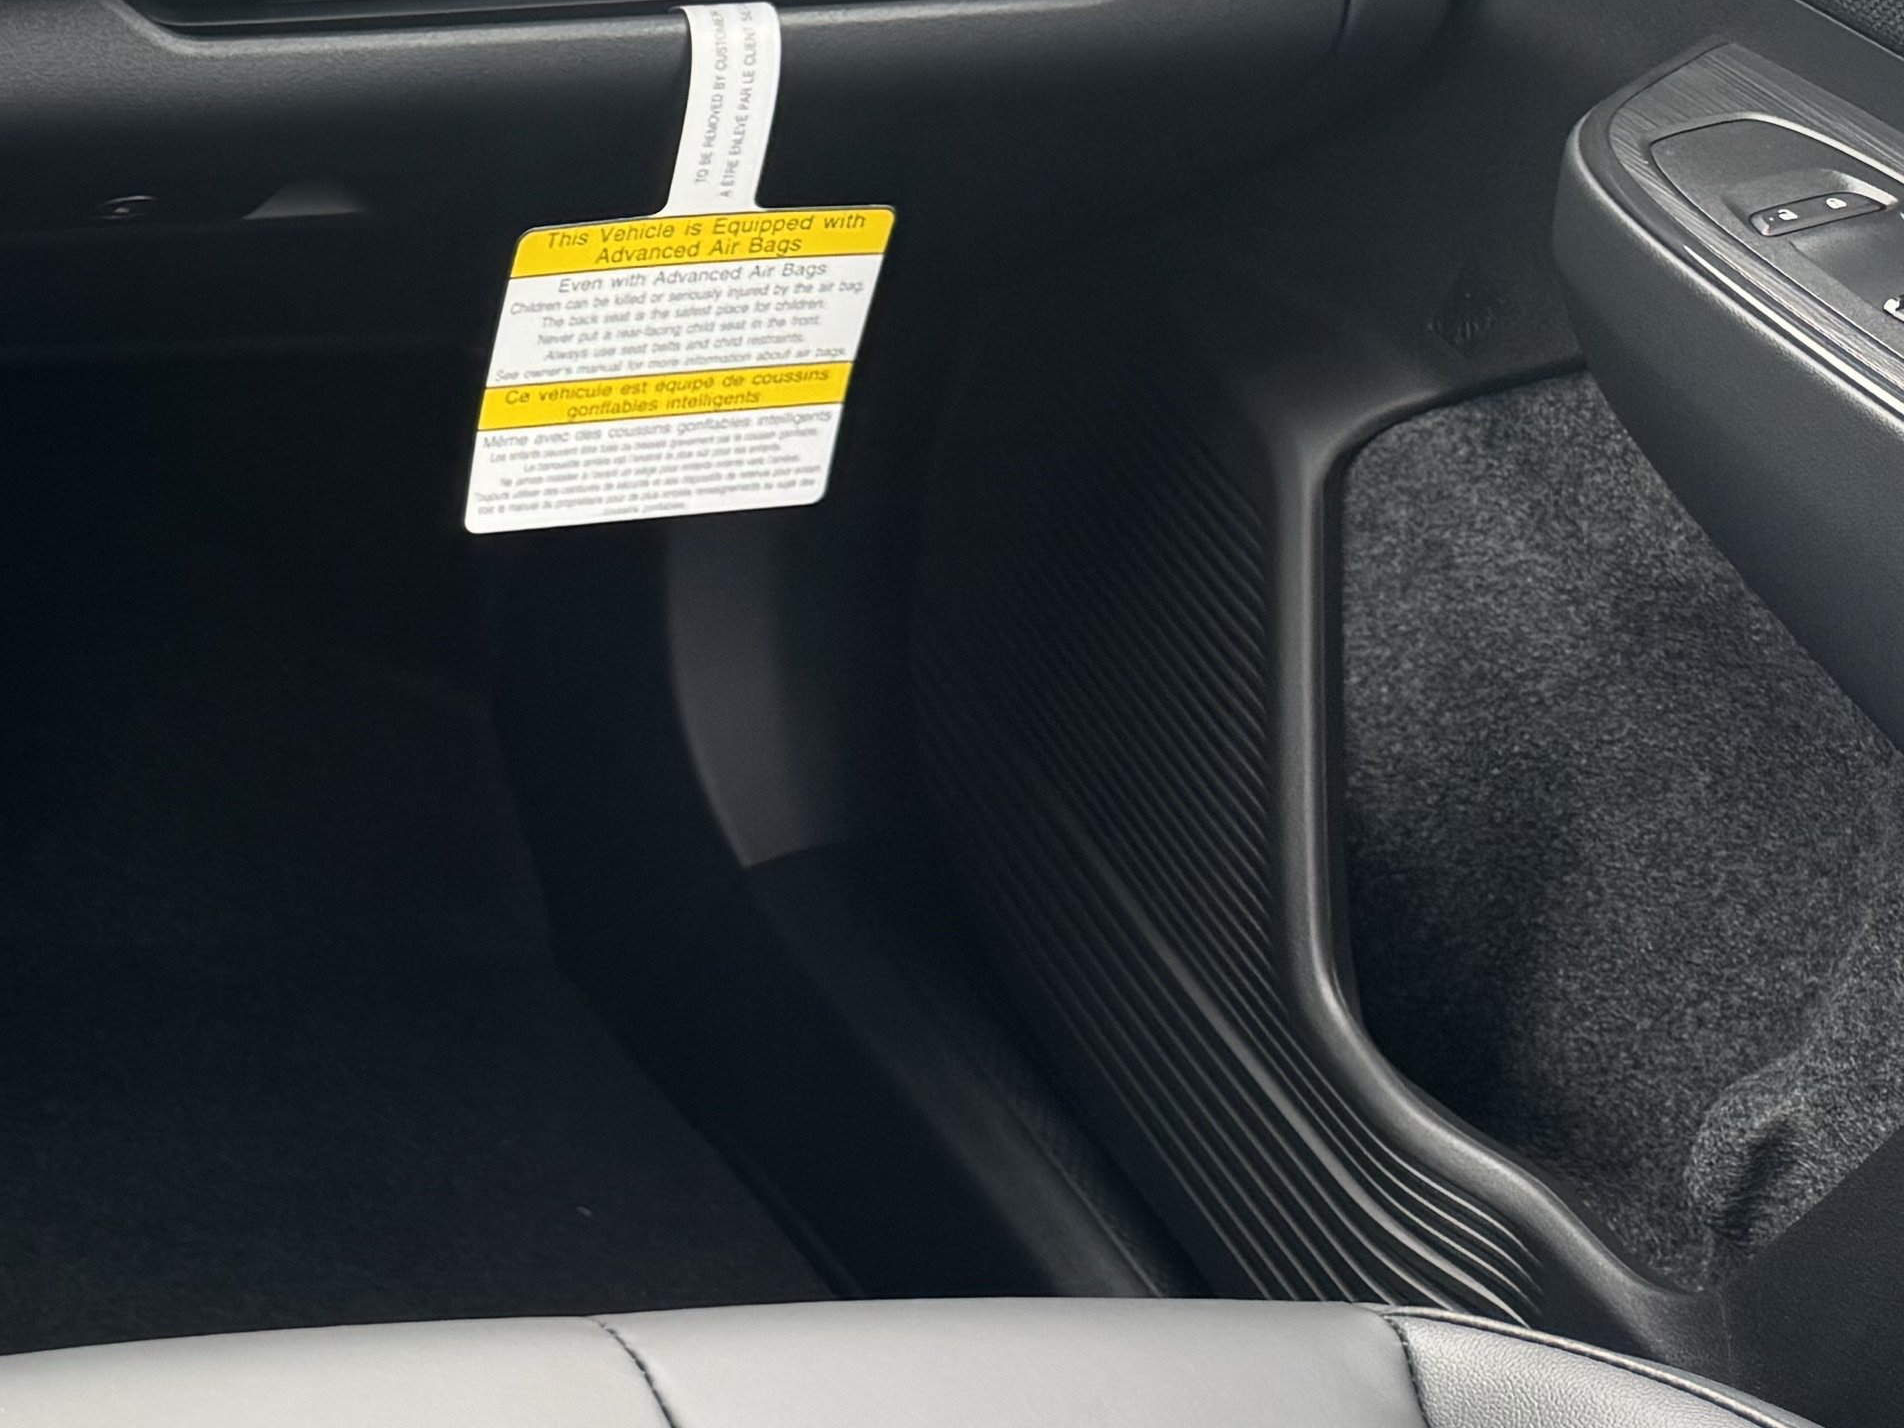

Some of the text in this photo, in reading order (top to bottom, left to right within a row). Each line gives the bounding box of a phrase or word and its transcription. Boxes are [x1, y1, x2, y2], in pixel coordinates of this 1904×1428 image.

[548, 213, 867, 249] This Vehicle is Equipped with
[594, 237, 805, 264] Advanced Air Bags
[558, 262, 827, 293] Even with Advanced Air Bags
